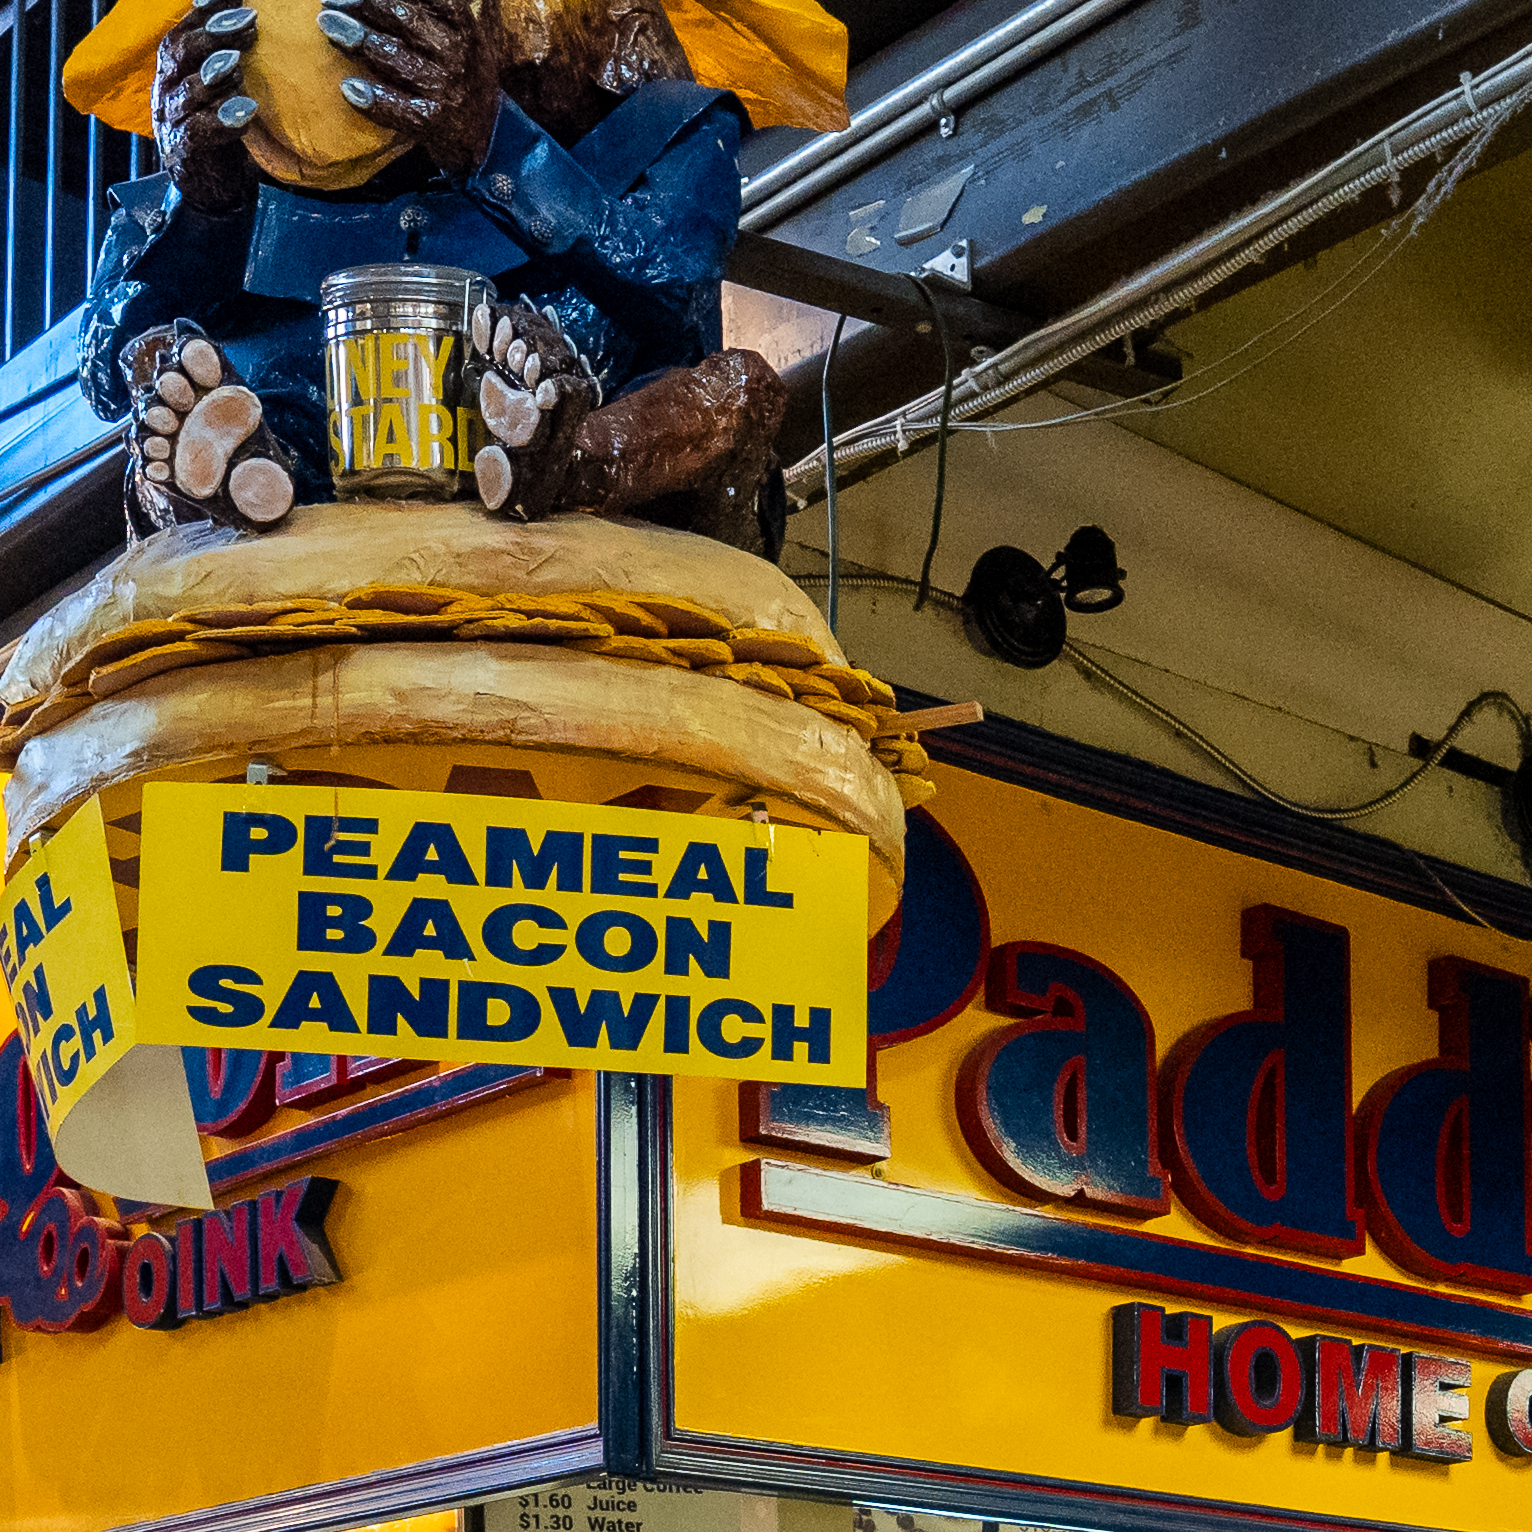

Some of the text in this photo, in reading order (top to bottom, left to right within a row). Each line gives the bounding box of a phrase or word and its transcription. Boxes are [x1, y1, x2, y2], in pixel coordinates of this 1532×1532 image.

[326, 333, 455, 400] NEY
[220, 810, 795, 909] PEAMEAL
[296, 890, 732, 980] BACON
[186, 963, 831, 1065] SANDWICH
[123, 1175, 343, 1330] OINK
[1112, 1301, 1473, 1465] HOME
[519, 1494, 638, 1513] $1.60 Juice
[519, 1512, 573, 1531] $1.30
[586, 1479, 637, 1494] Large
